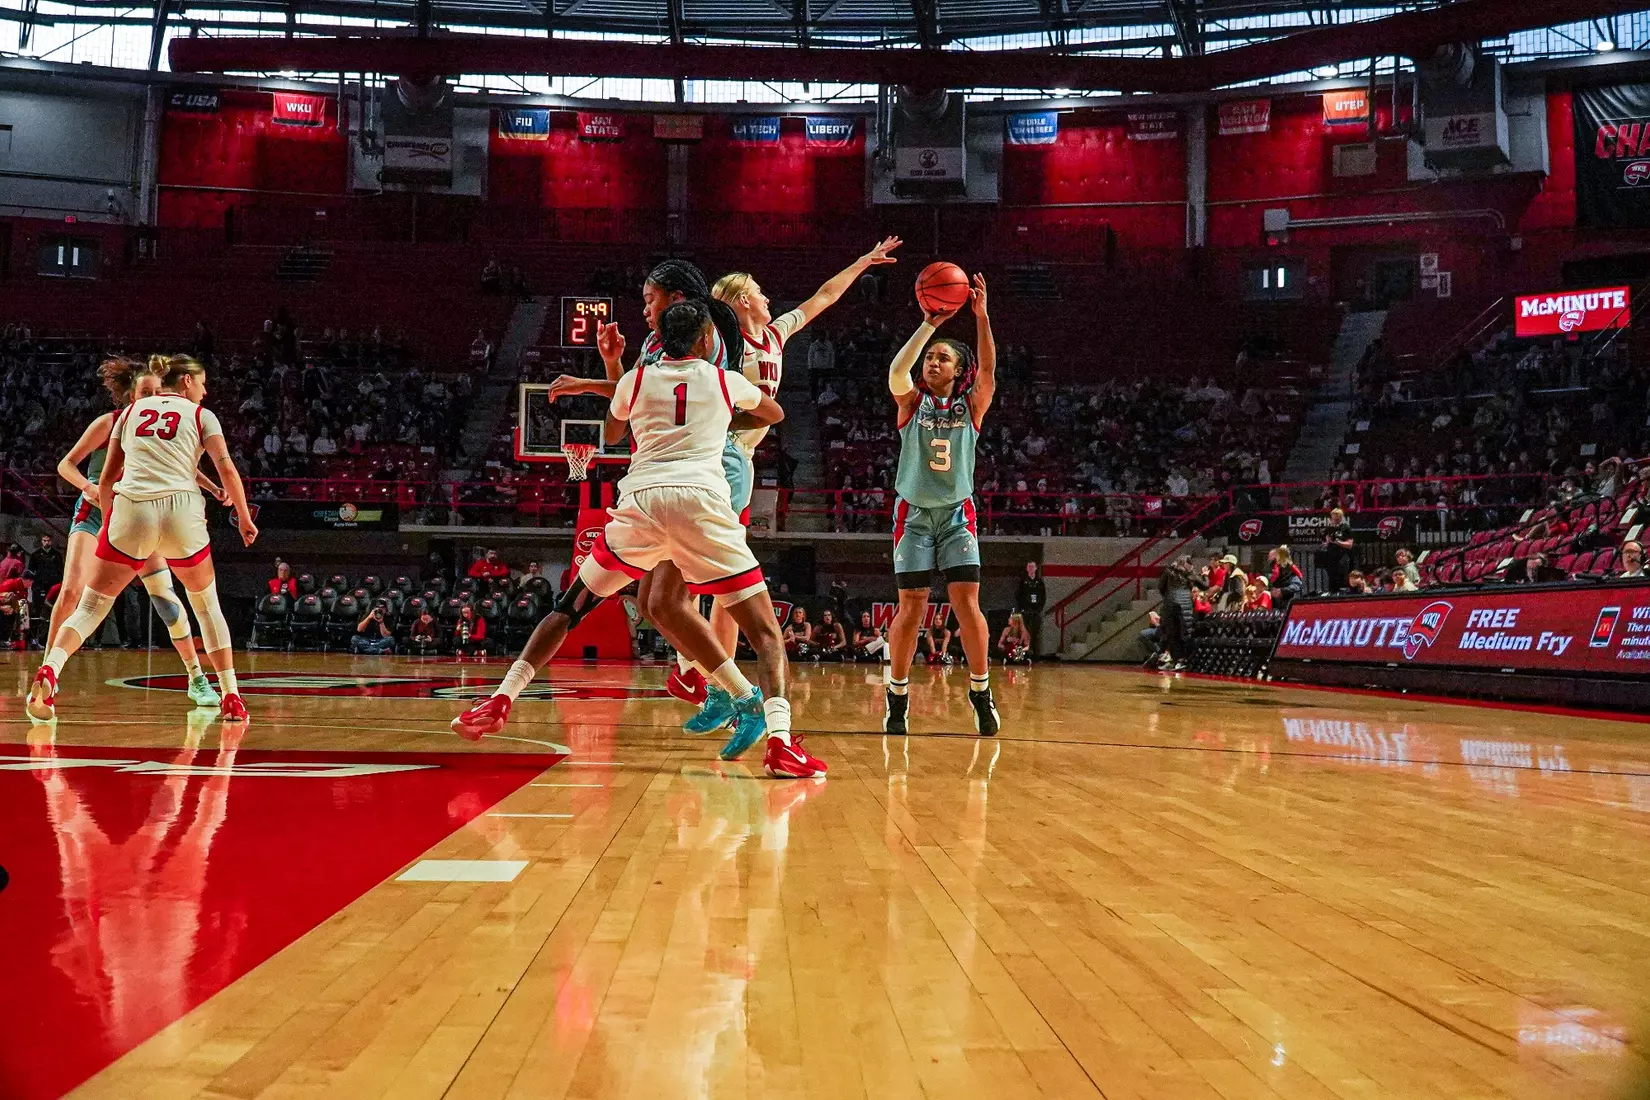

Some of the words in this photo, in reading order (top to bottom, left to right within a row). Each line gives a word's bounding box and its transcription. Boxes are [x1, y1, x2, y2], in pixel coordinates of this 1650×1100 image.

[186, 94, 218, 107] USA
[286, 102, 312, 113] WKU
[1335, 100, 1364, 111] UTEP
[515, 117, 533, 127] FIU
[749, 125, 777, 134] TECH
[1448, 117, 1479, 134] ACE
[585, 125, 619, 136] STATE
[809, 125, 854, 135] LIBERTY
[576, 302, 607, 316] 9:49
[1520, 291, 1625, 317] McMINUTE
[673, 382, 688, 426] 1
[135, 408, 181, 441] 23
[929, 437, 952, 473] 3
[1421, 612, 1440, 629] WKU
[1466, 608, 1520, 629] FREE
[1281, 618, 1412, 648] McMINUTE
[1627, 622, 1643, 633] The
[1459, 632, 1533, 651] Medium
[1535, 632, 1573, 656] Fry
